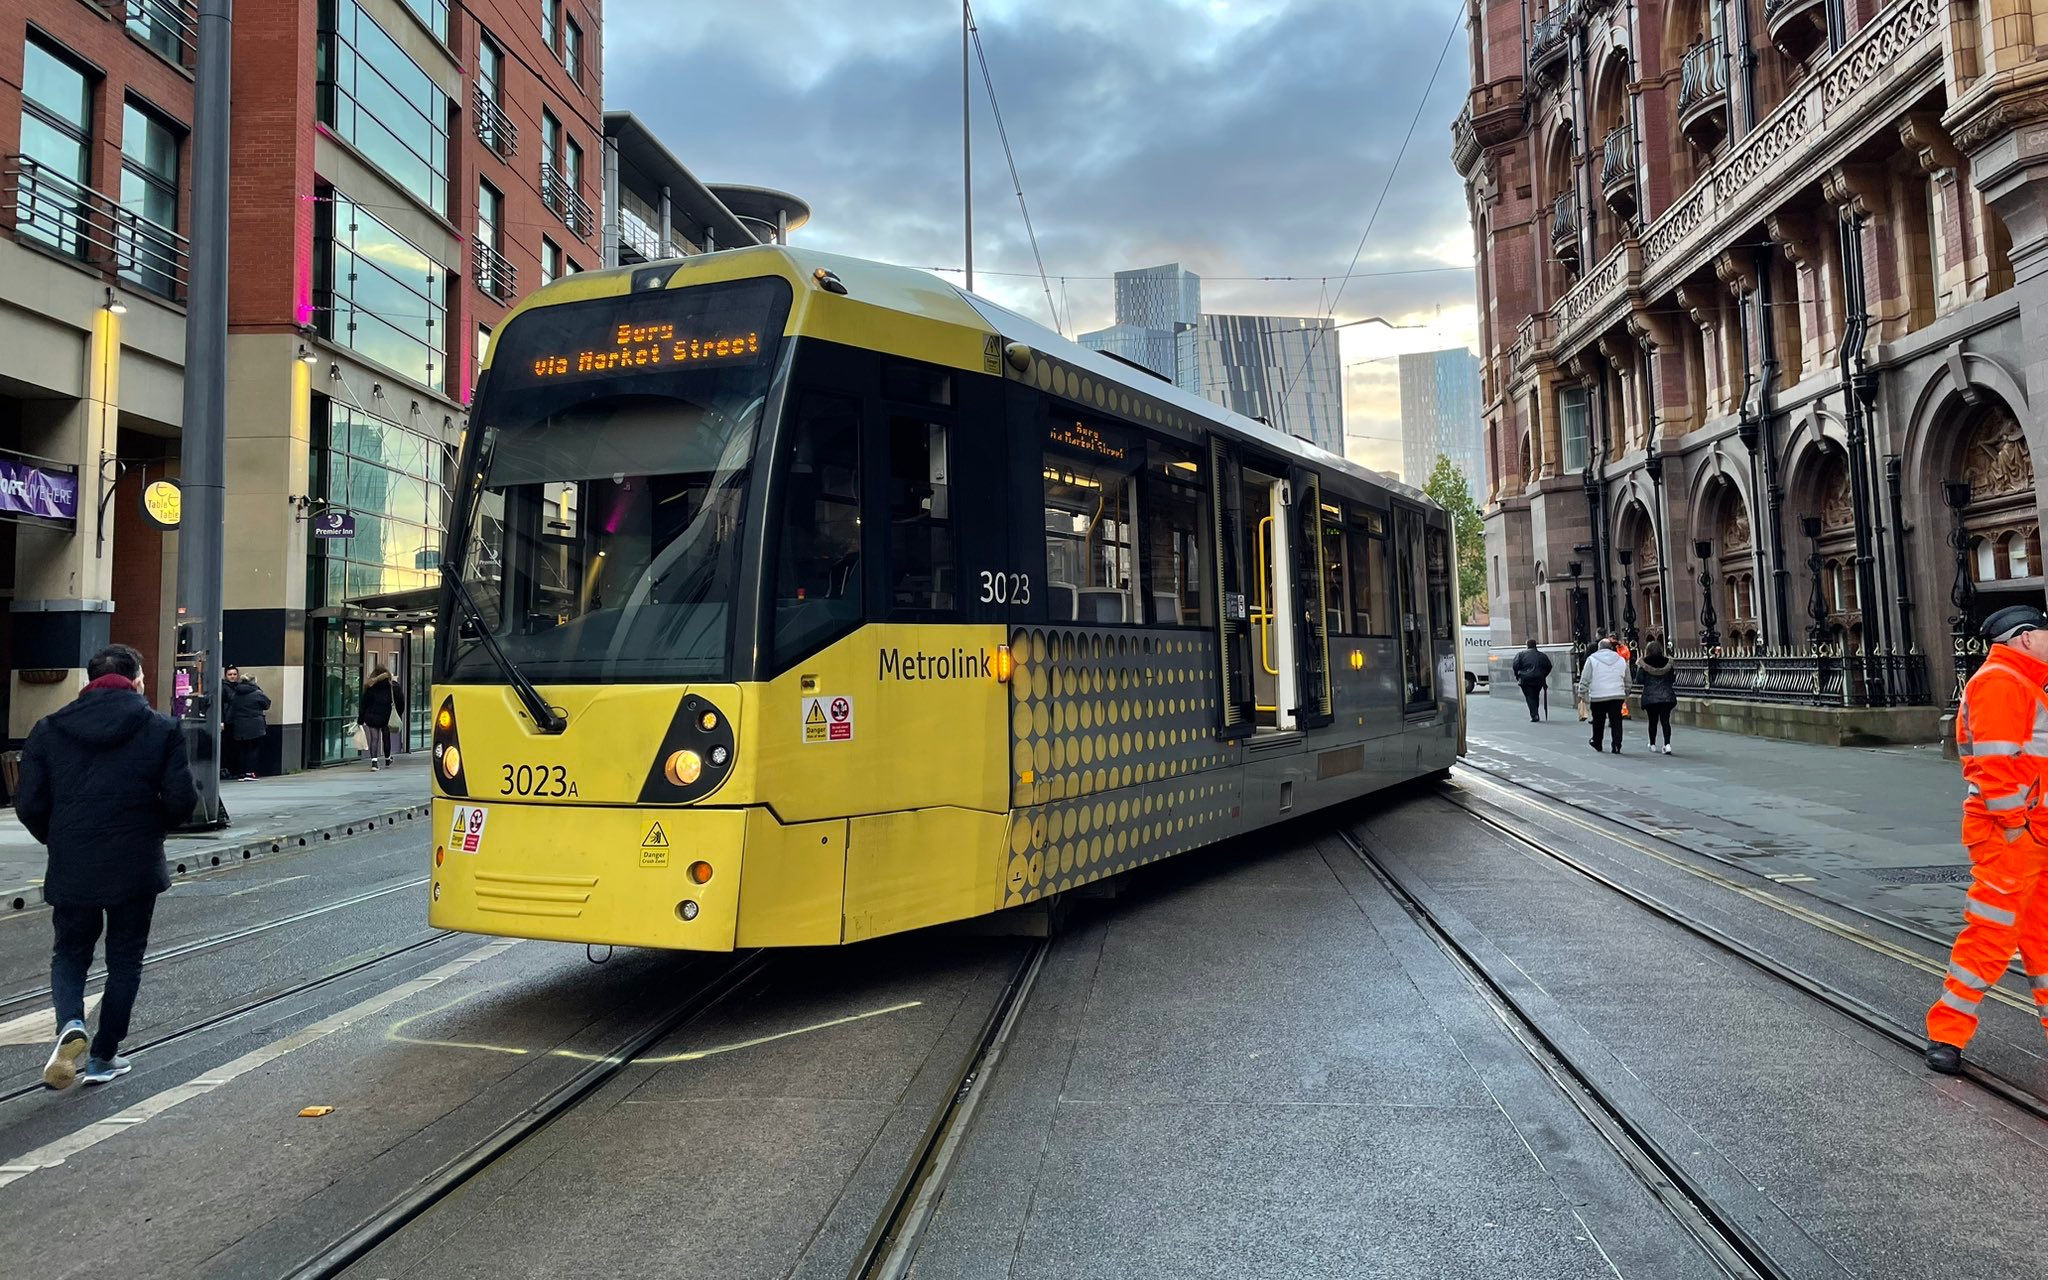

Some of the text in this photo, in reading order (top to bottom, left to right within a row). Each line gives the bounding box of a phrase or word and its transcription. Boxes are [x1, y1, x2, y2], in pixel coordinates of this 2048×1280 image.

[617, 324, 673, 344] Bury
[535, 332, 757, 376] via Market Street
[46, 487, 73, 504] HERE
[148, 498, 168, 509] Table
[160, 508, 179, 519] Table
[980, 570, 1031, 604] 3023
[879, 648, 992, 681] Metrolink
